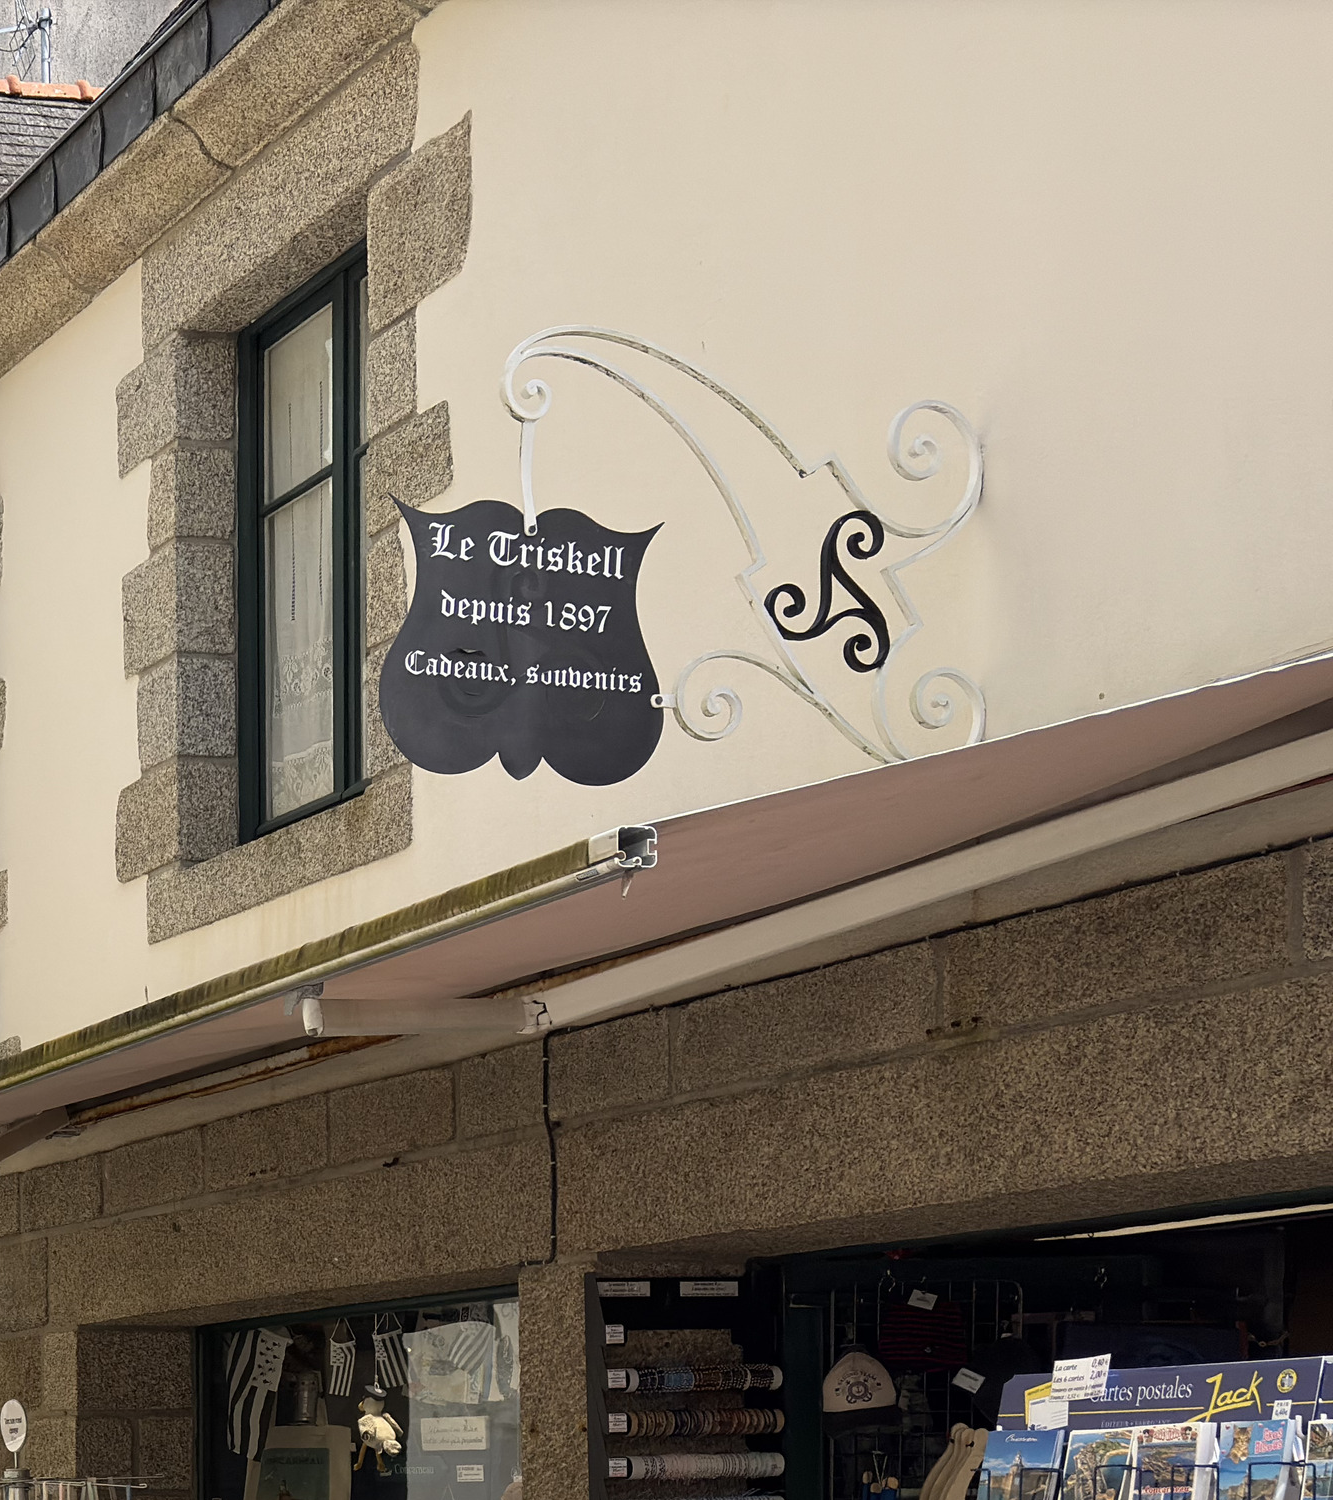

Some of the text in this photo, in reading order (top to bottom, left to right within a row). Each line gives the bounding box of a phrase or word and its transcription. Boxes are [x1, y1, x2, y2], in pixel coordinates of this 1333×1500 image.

[429, 522, 625, 580] Le Triskell
[440, 589, 612, 634] depuis 1897
[404, 649, 643, 693] Cadeaux, souvenirs
[1090, 1385, 1134, 1402] artes
[1134, 1375, 1193, 1407] postales
[1202, 1371, 1264, 1422] Jack
[1144, 1485, 1191, 1494] Concareau
